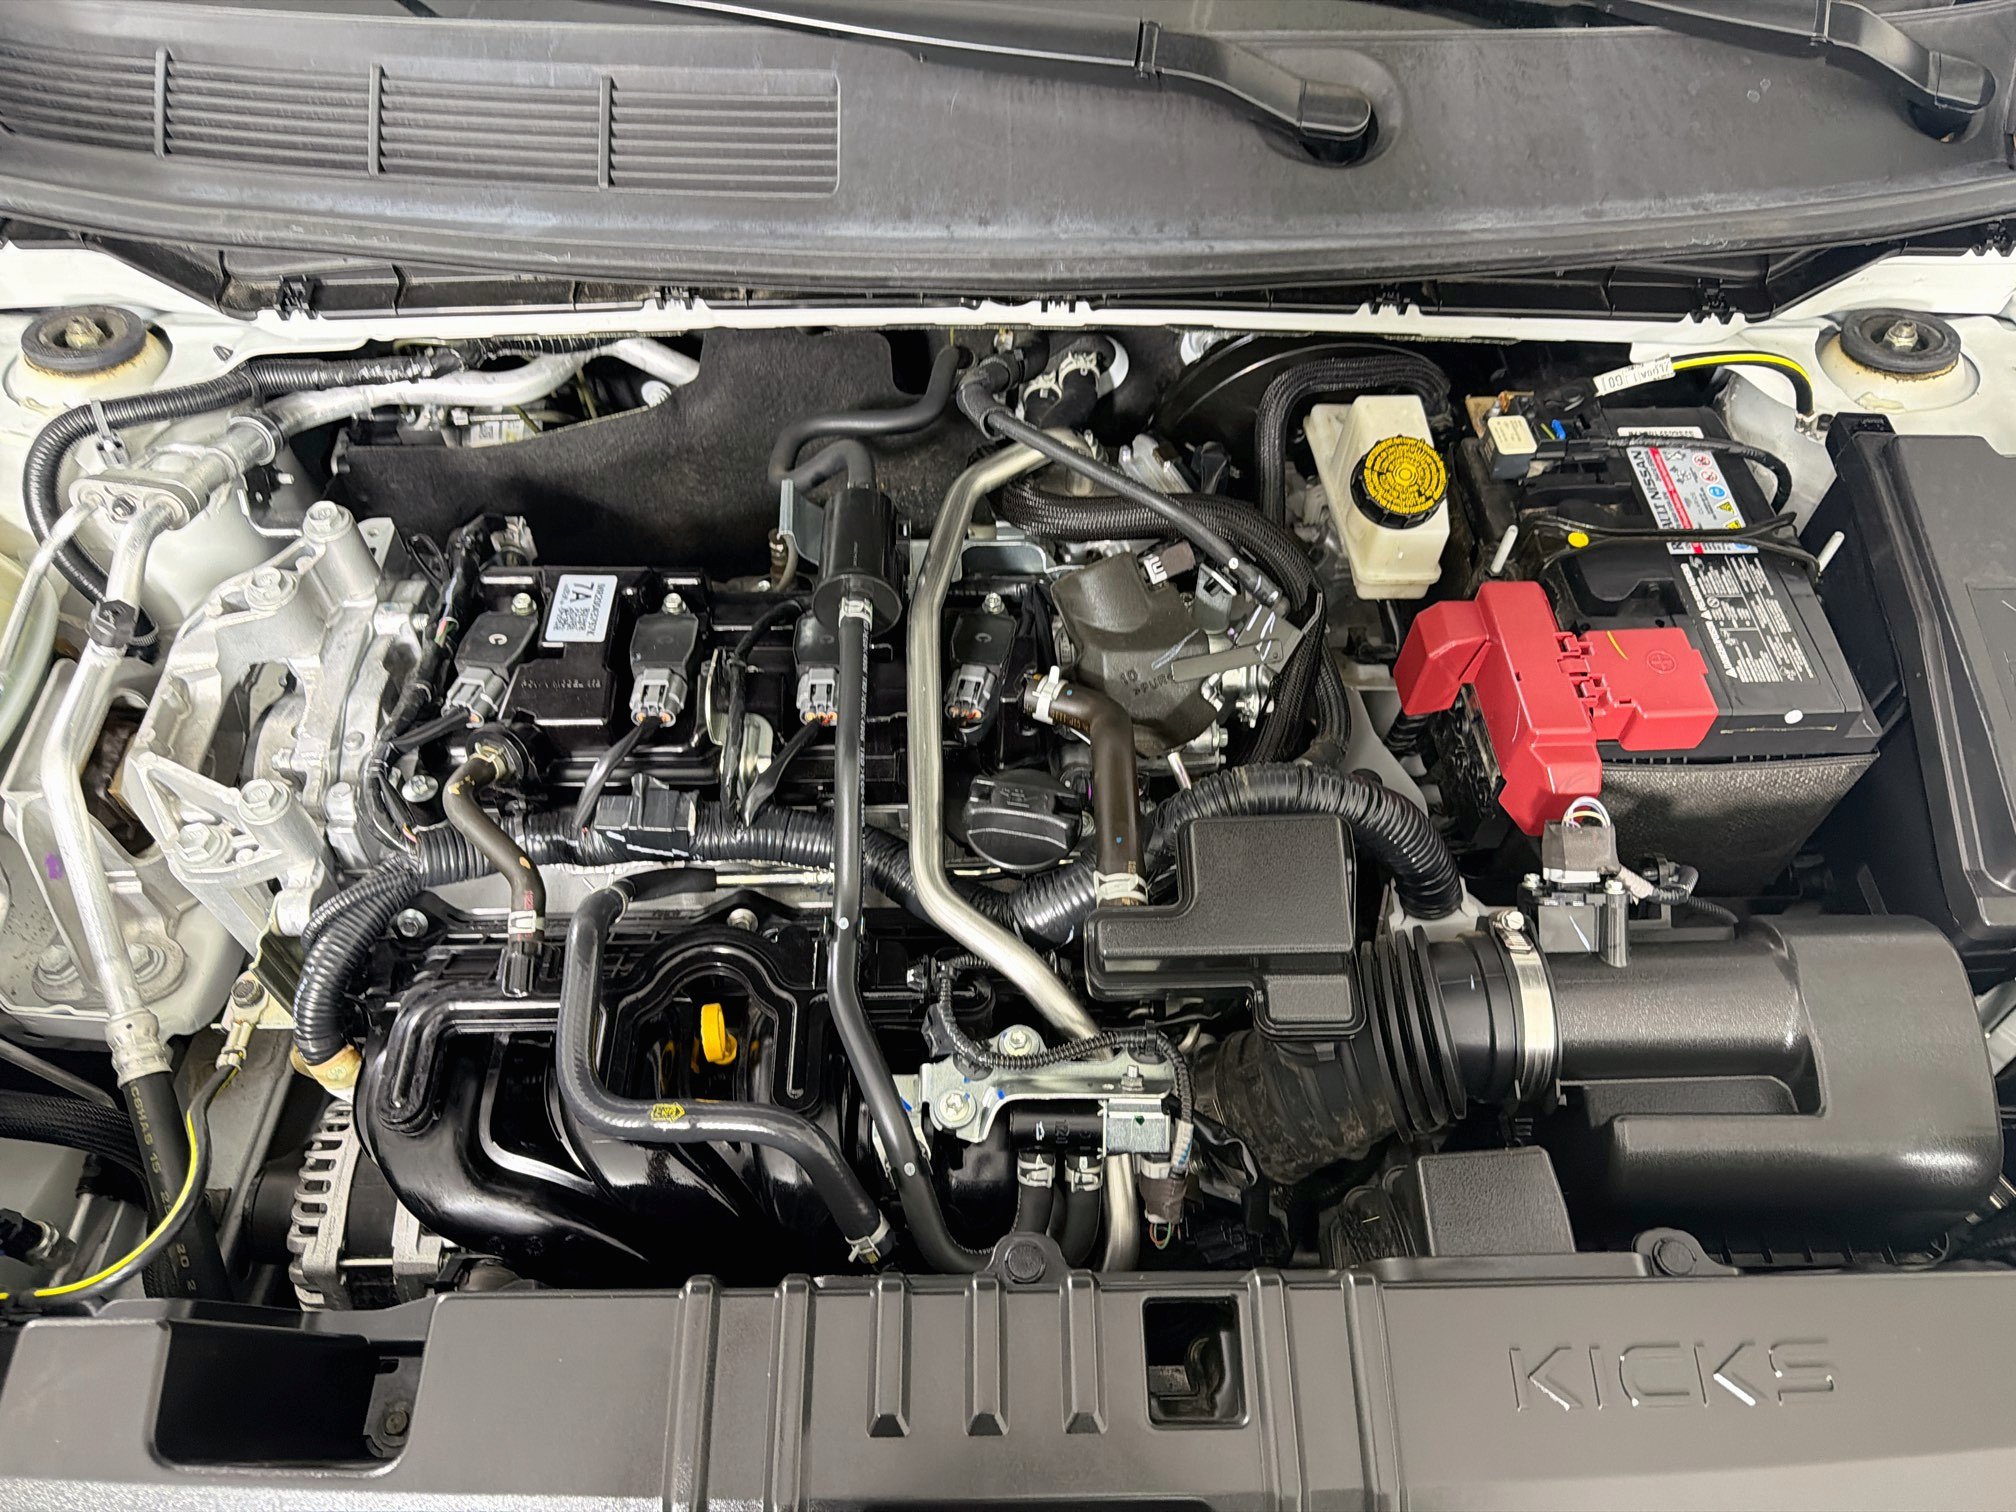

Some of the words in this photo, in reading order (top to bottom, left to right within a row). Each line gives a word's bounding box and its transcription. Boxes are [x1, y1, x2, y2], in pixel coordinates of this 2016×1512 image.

[1630, 450, 1662, 501] NISSAN
[570, 581, 594, 604] 7A
[1508, 1337, 1835, 1411] KICKS
